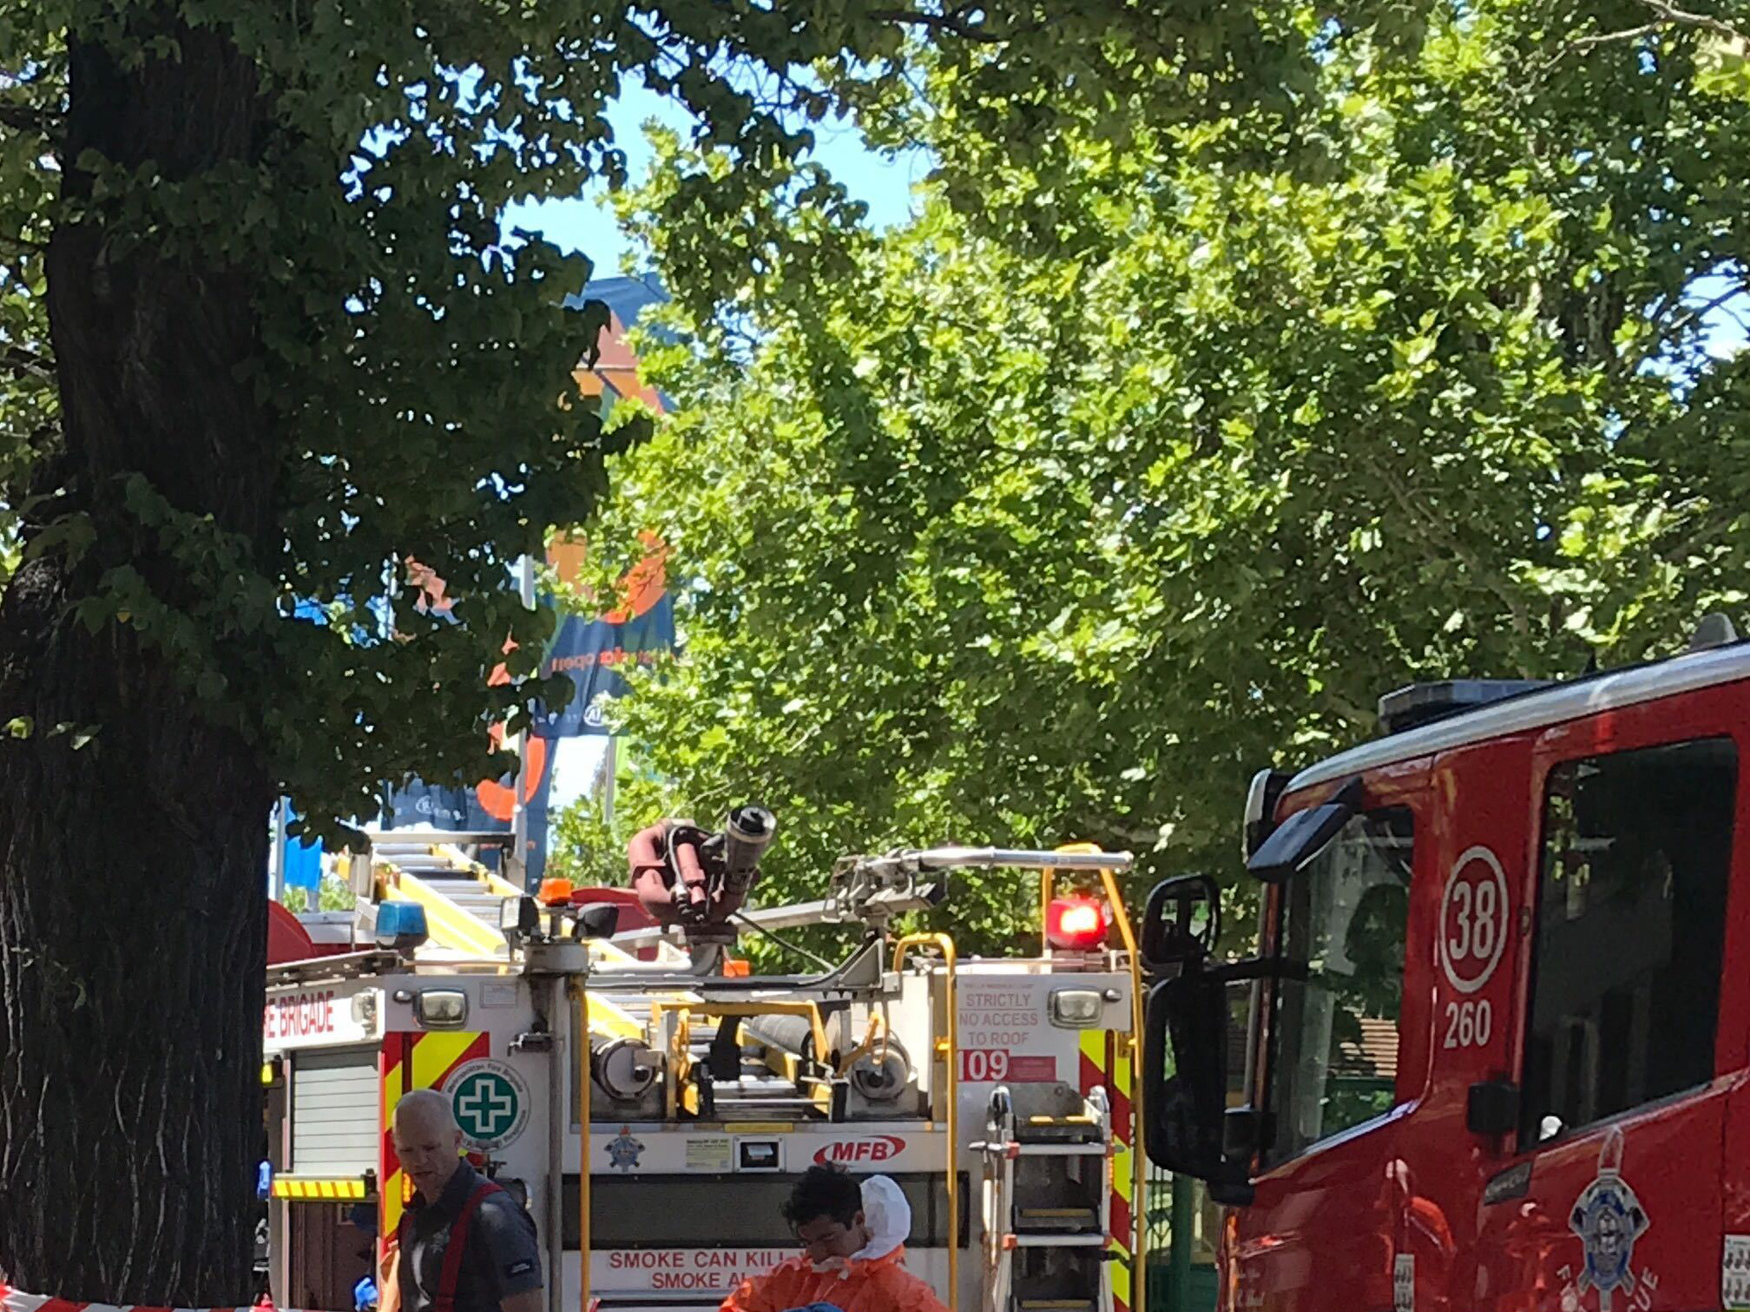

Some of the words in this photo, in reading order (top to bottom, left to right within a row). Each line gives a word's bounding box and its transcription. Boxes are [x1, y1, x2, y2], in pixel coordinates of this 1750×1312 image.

[1450, 880, 1496, 960] 38
[965, 993, 1031, 1007] STRICTLY
[280, 990, 334, 1037] BRIGADE
[959, 1013, 978, 1026] NO
[982, 1012, 1038, 1026] ACCESS
[1443, 1000, 1492, 1048] 260
[968, 1032, 987, 1046] TO
[991, 1032, 1030, 1046] ROOF
[832, 1142, 889, 1161] MFB
[610, 1251, 684, 1268] SMOKE
[694, 1251, 737, 1267] CAN
[652, 1272, 720, 1289] SMOKE
